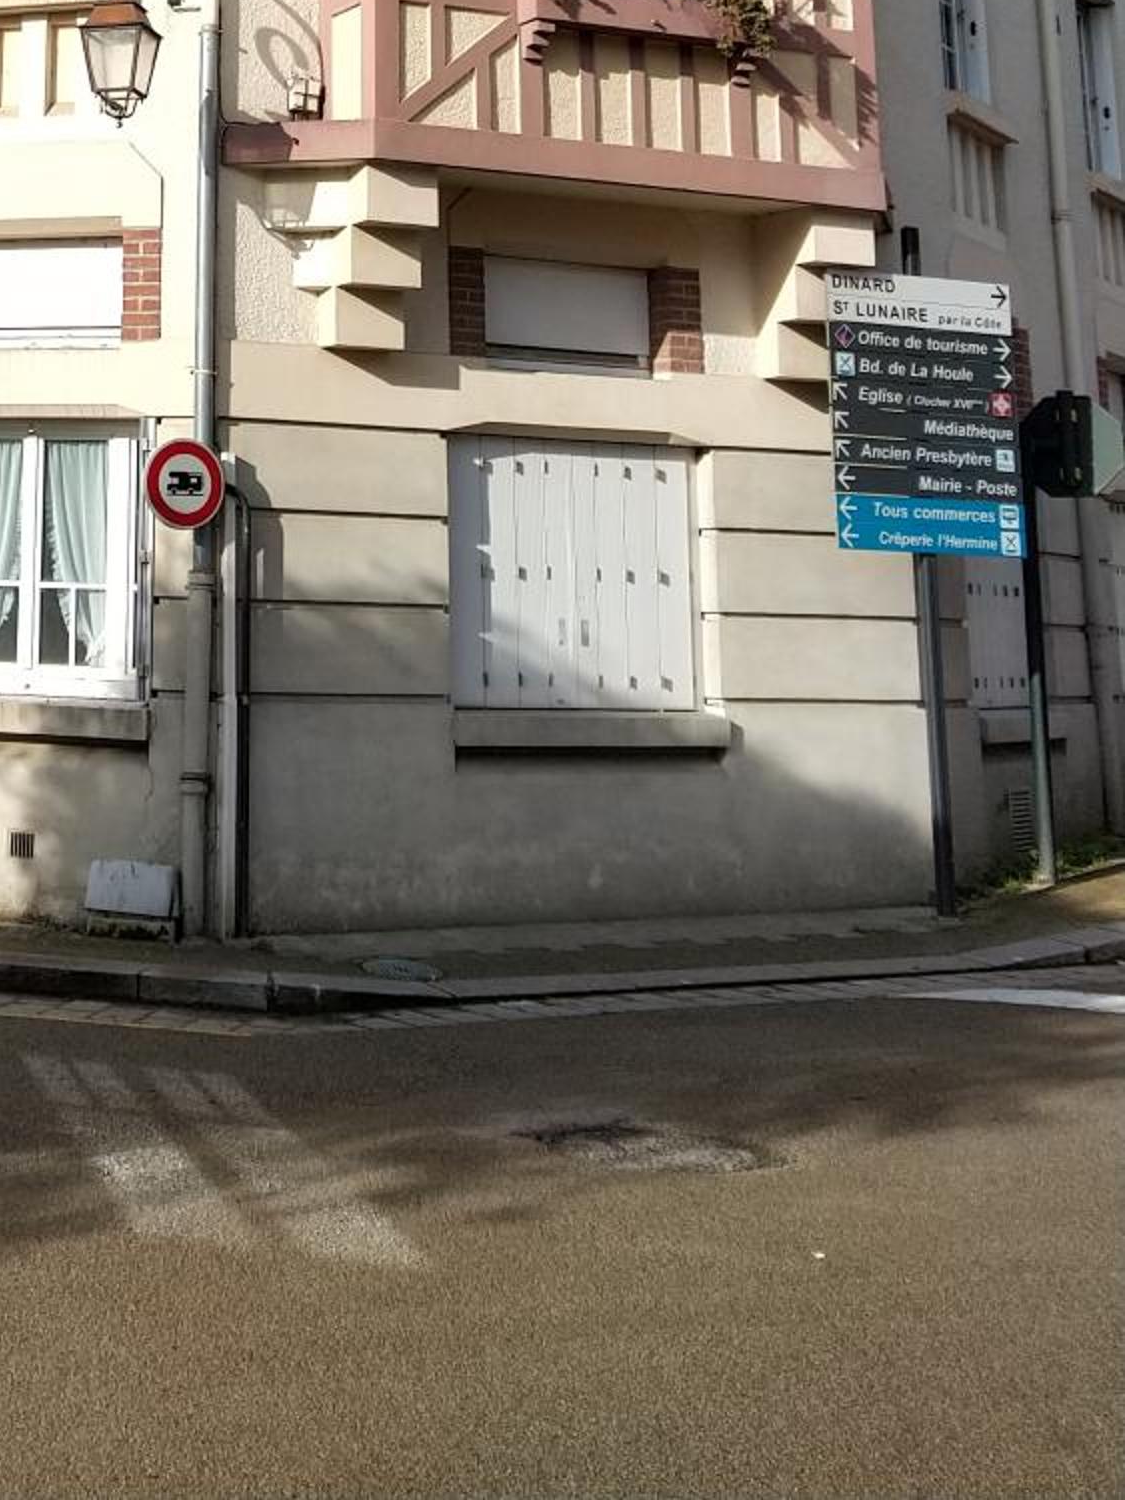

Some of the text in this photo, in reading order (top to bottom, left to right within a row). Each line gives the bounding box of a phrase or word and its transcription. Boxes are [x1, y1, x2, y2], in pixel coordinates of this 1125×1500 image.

[832, 274, 896, 293] DINARD
[856, 302, 928, 322] LUNAIRE
[858, 330, 988, 355] Office de tourisme
[859, 358, 974, 381] Bd. de La Houle
[858, 386, 904, 405] Eglise
[924, 419, 1014, 443] Médiathèque
[860, 443, 992, 468] Ancien Presbytère
[918, 475, 963, 493] Mairie
[977, 480, 1017, 496] Poste
[874, 501, 996, 523] Tous commerces
[878, 530, 998, 550] Crêperie l'Hermine
